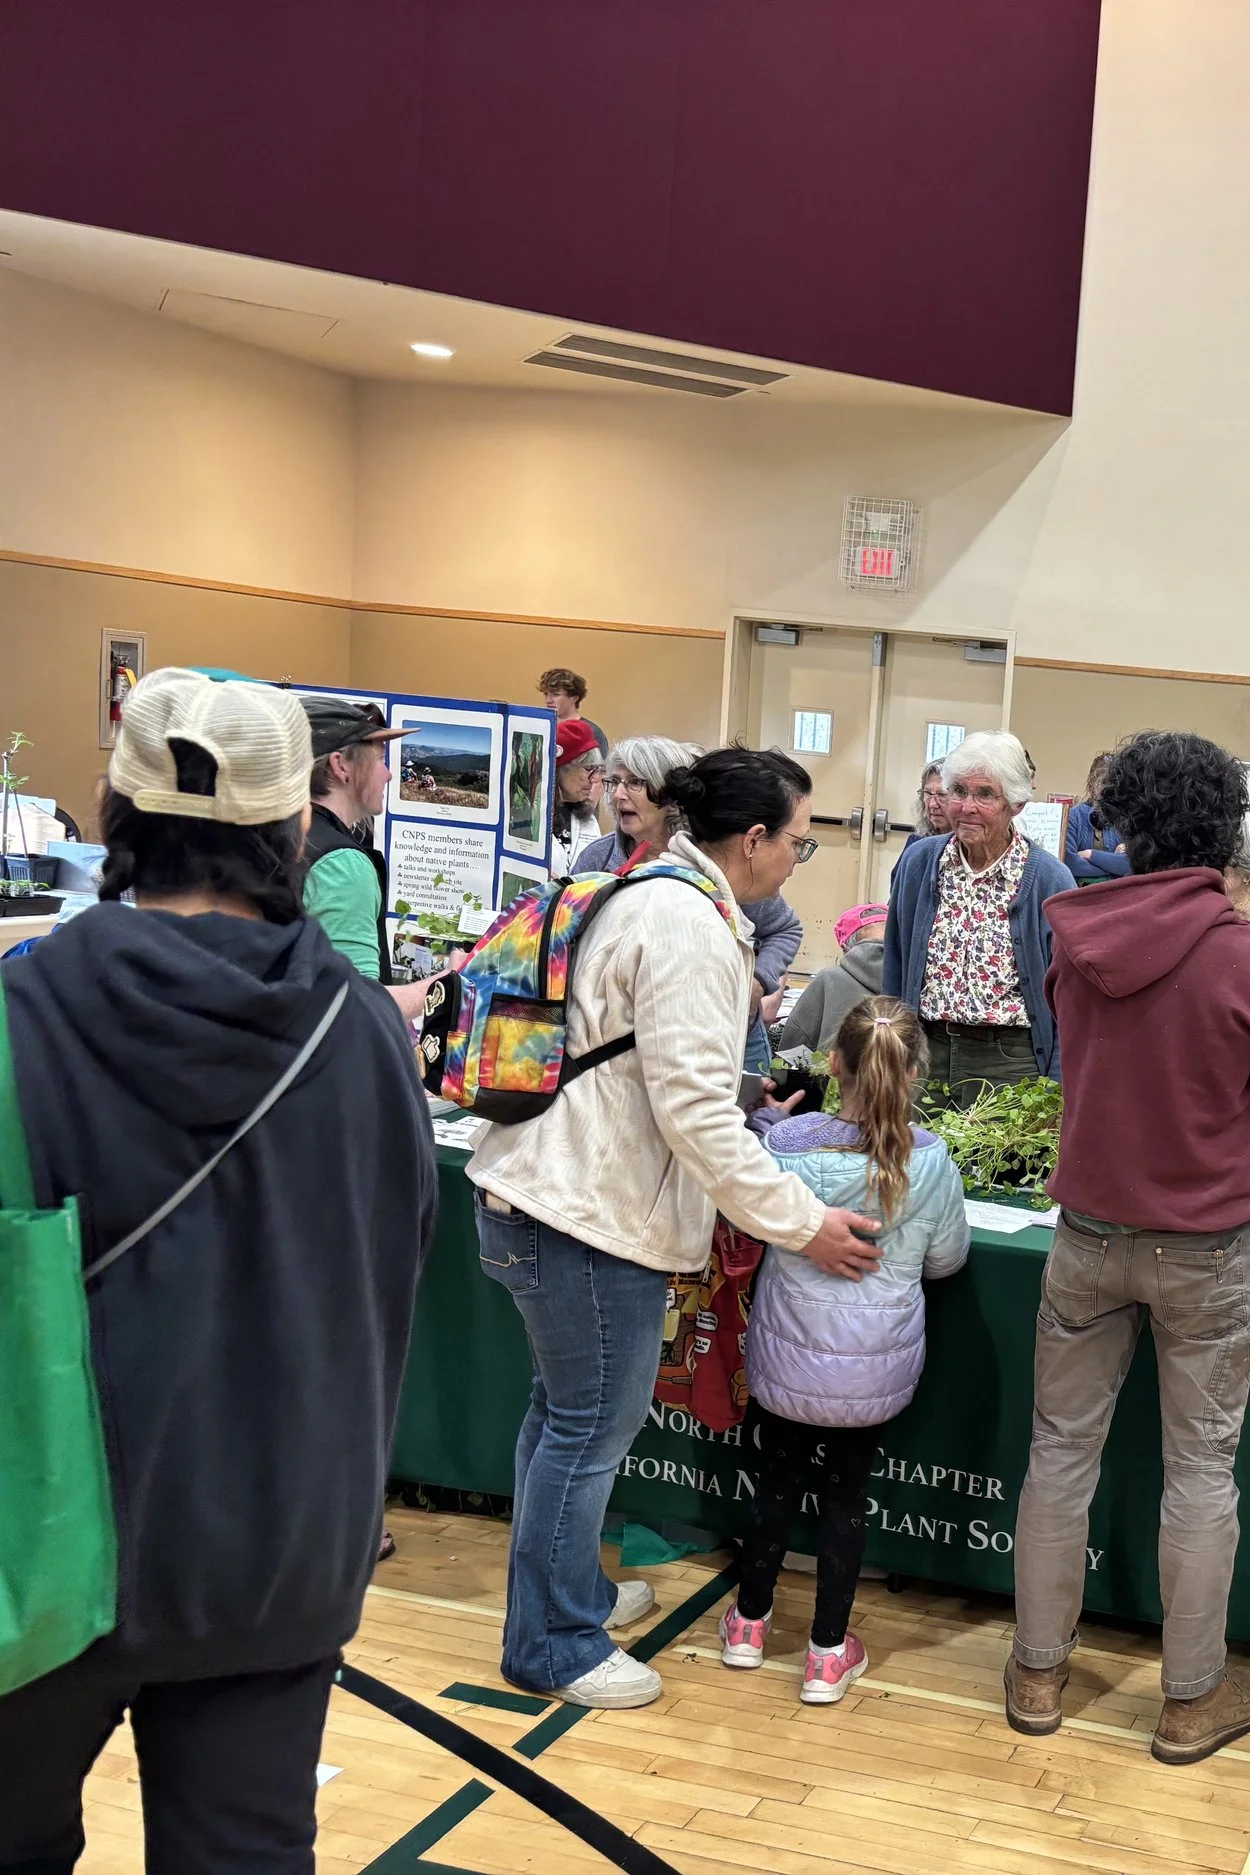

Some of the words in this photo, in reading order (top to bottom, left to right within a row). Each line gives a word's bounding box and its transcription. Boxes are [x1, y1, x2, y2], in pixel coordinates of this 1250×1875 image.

[862, 548, 894, 576] EXIT
[402, 830, 426, 840] CNPS
[428, 834, 462, 844] members
[465, 838, 483, 847] share
[394, 842, 432, 854] knowledge
[434, 847, 447, 855] and
[449, 848, 489, 859] information
[404, 854, 424, 862] about
[426, 858, 447, 866] native
[428, 868, 455, 876] workshops
[404, 882, 419, 890] spring
[616, 1455, 722, 1497] FORNIA
